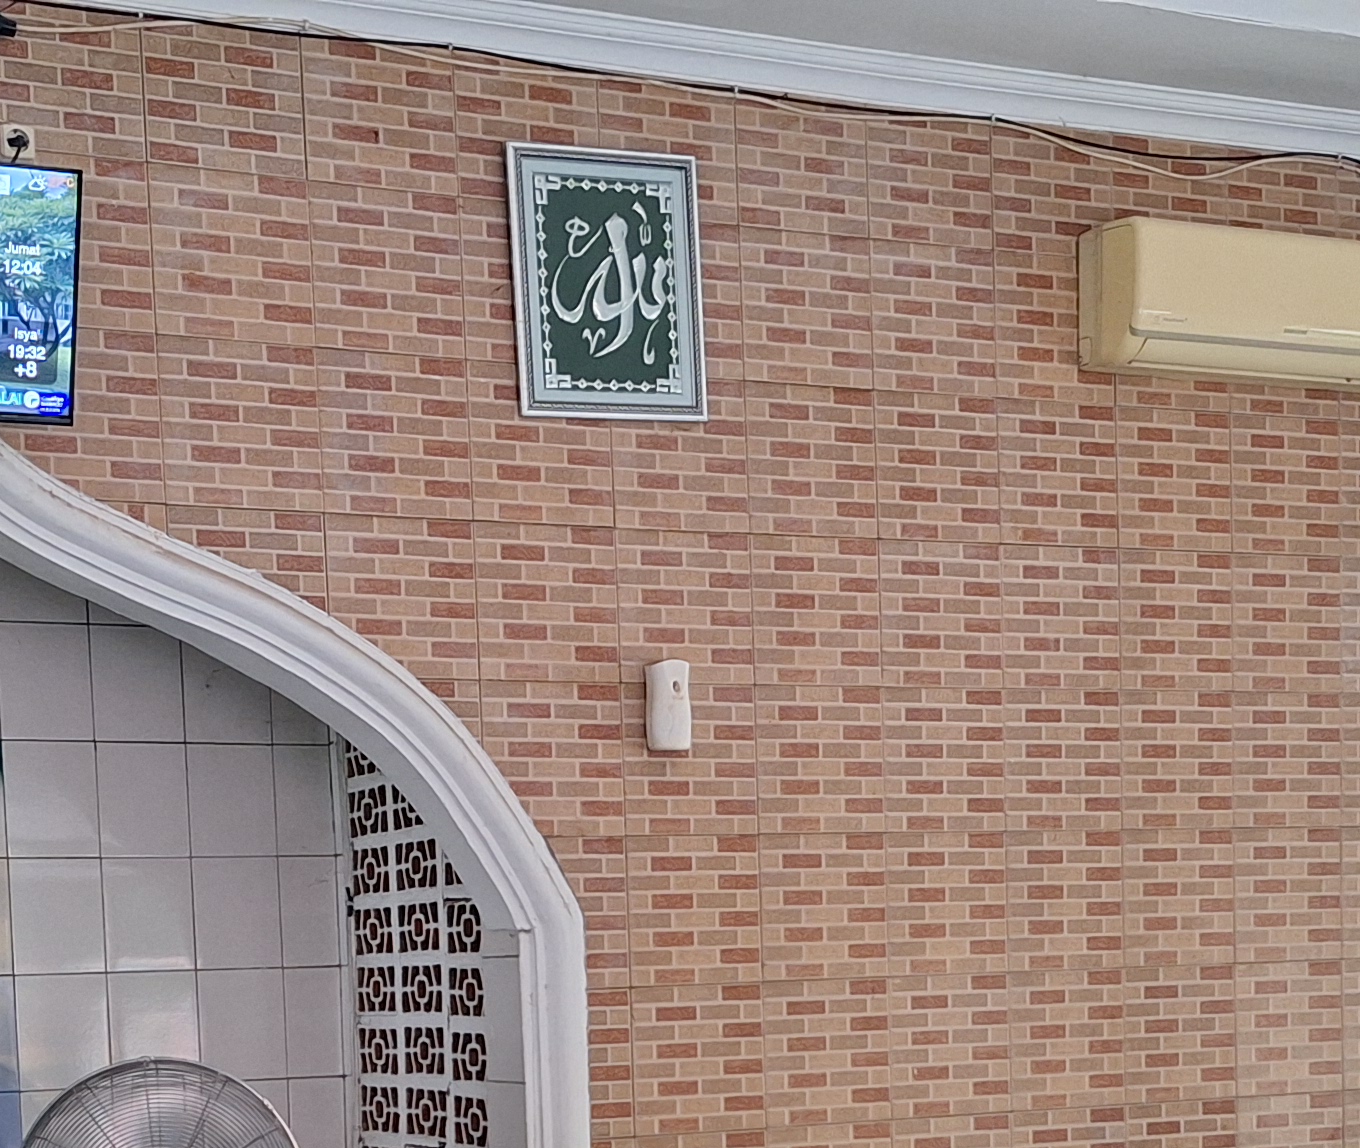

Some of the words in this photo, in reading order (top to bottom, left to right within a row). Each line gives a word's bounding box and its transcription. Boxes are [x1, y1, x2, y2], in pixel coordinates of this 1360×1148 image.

[5, 241, 41, 256] Jumat
[4, 259, 41, 275] 12:04
[7, 344, 46, 360] 19:32
[14, 361, 37, 378] +8
